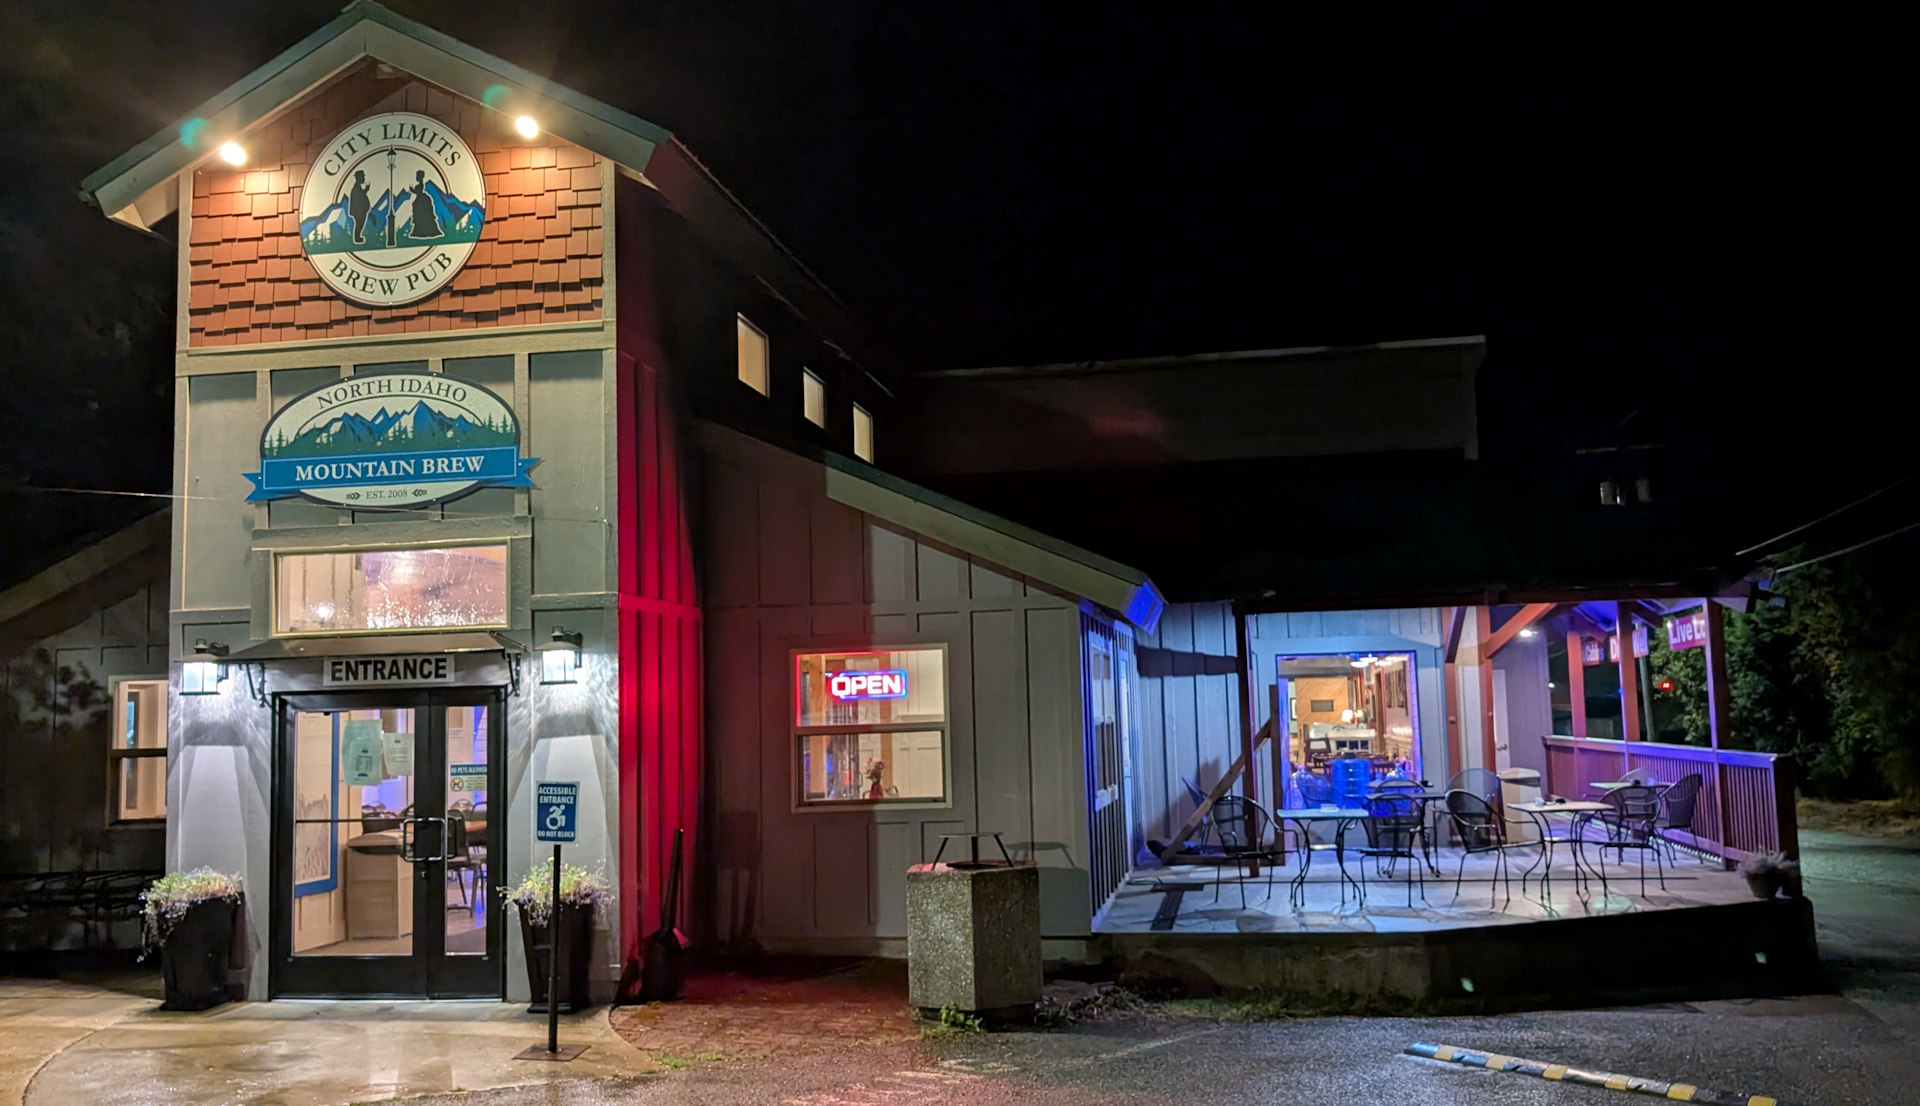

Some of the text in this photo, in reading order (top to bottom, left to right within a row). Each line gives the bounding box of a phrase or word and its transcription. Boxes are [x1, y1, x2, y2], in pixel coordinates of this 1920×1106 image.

[324, 123, 461, 177] CITY LIMITS
[329, 252, 452, 296] BREW PUB
[318, 378, 467, 409] NORTH IDAHO
[295, 456, 485, 481] MOUNTAIN BREW
[366, 489, 408, 500] EST. 2008
[1669, 620, 1693, 644] Live
[330, 657, 447, 682] ENTRANCE
[831, 674, 901, 696] OPEN
[539, 786, 576, 795] ACCESSIBLE
[540, 795, 574, 804] ENTRANCE
